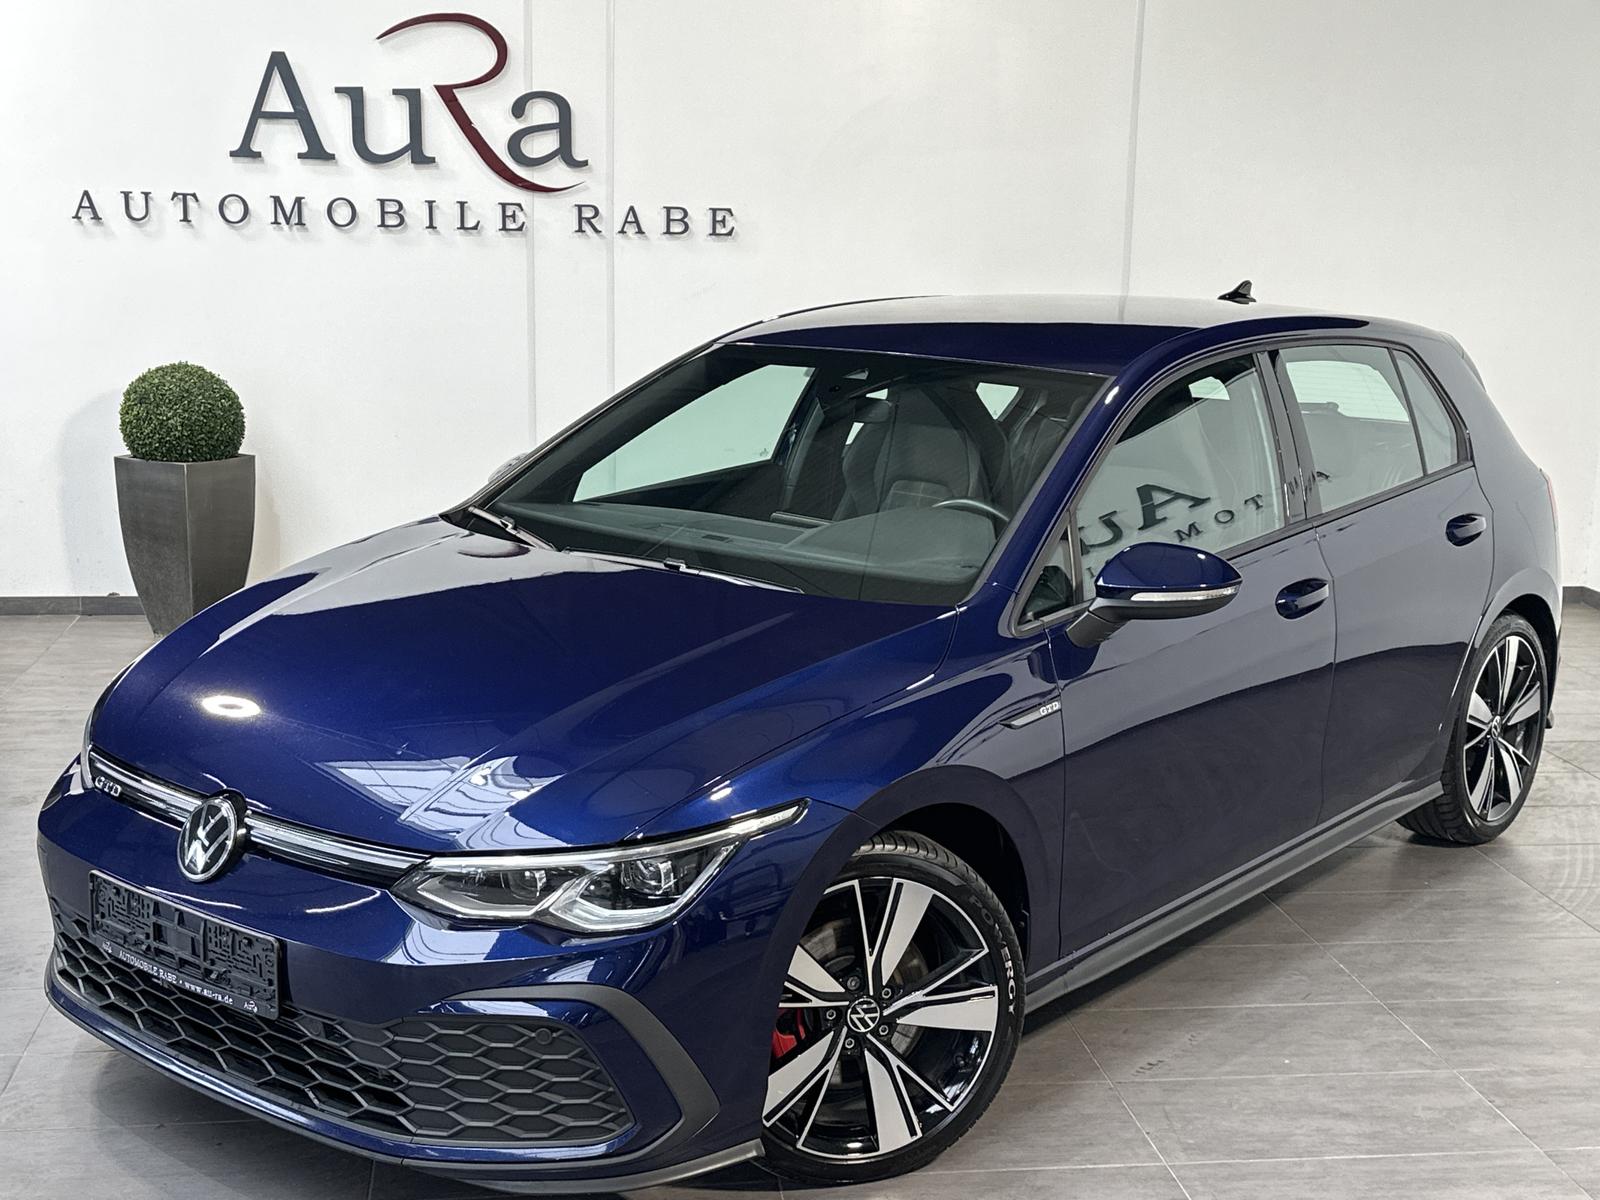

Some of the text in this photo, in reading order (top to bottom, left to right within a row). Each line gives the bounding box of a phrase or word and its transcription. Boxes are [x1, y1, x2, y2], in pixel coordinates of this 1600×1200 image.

[72, 191, 734, 236] AUTOMOBILE RABE
[1039, 701, 1059, 716] GTD
[94, 776, 122, 797] GTD
